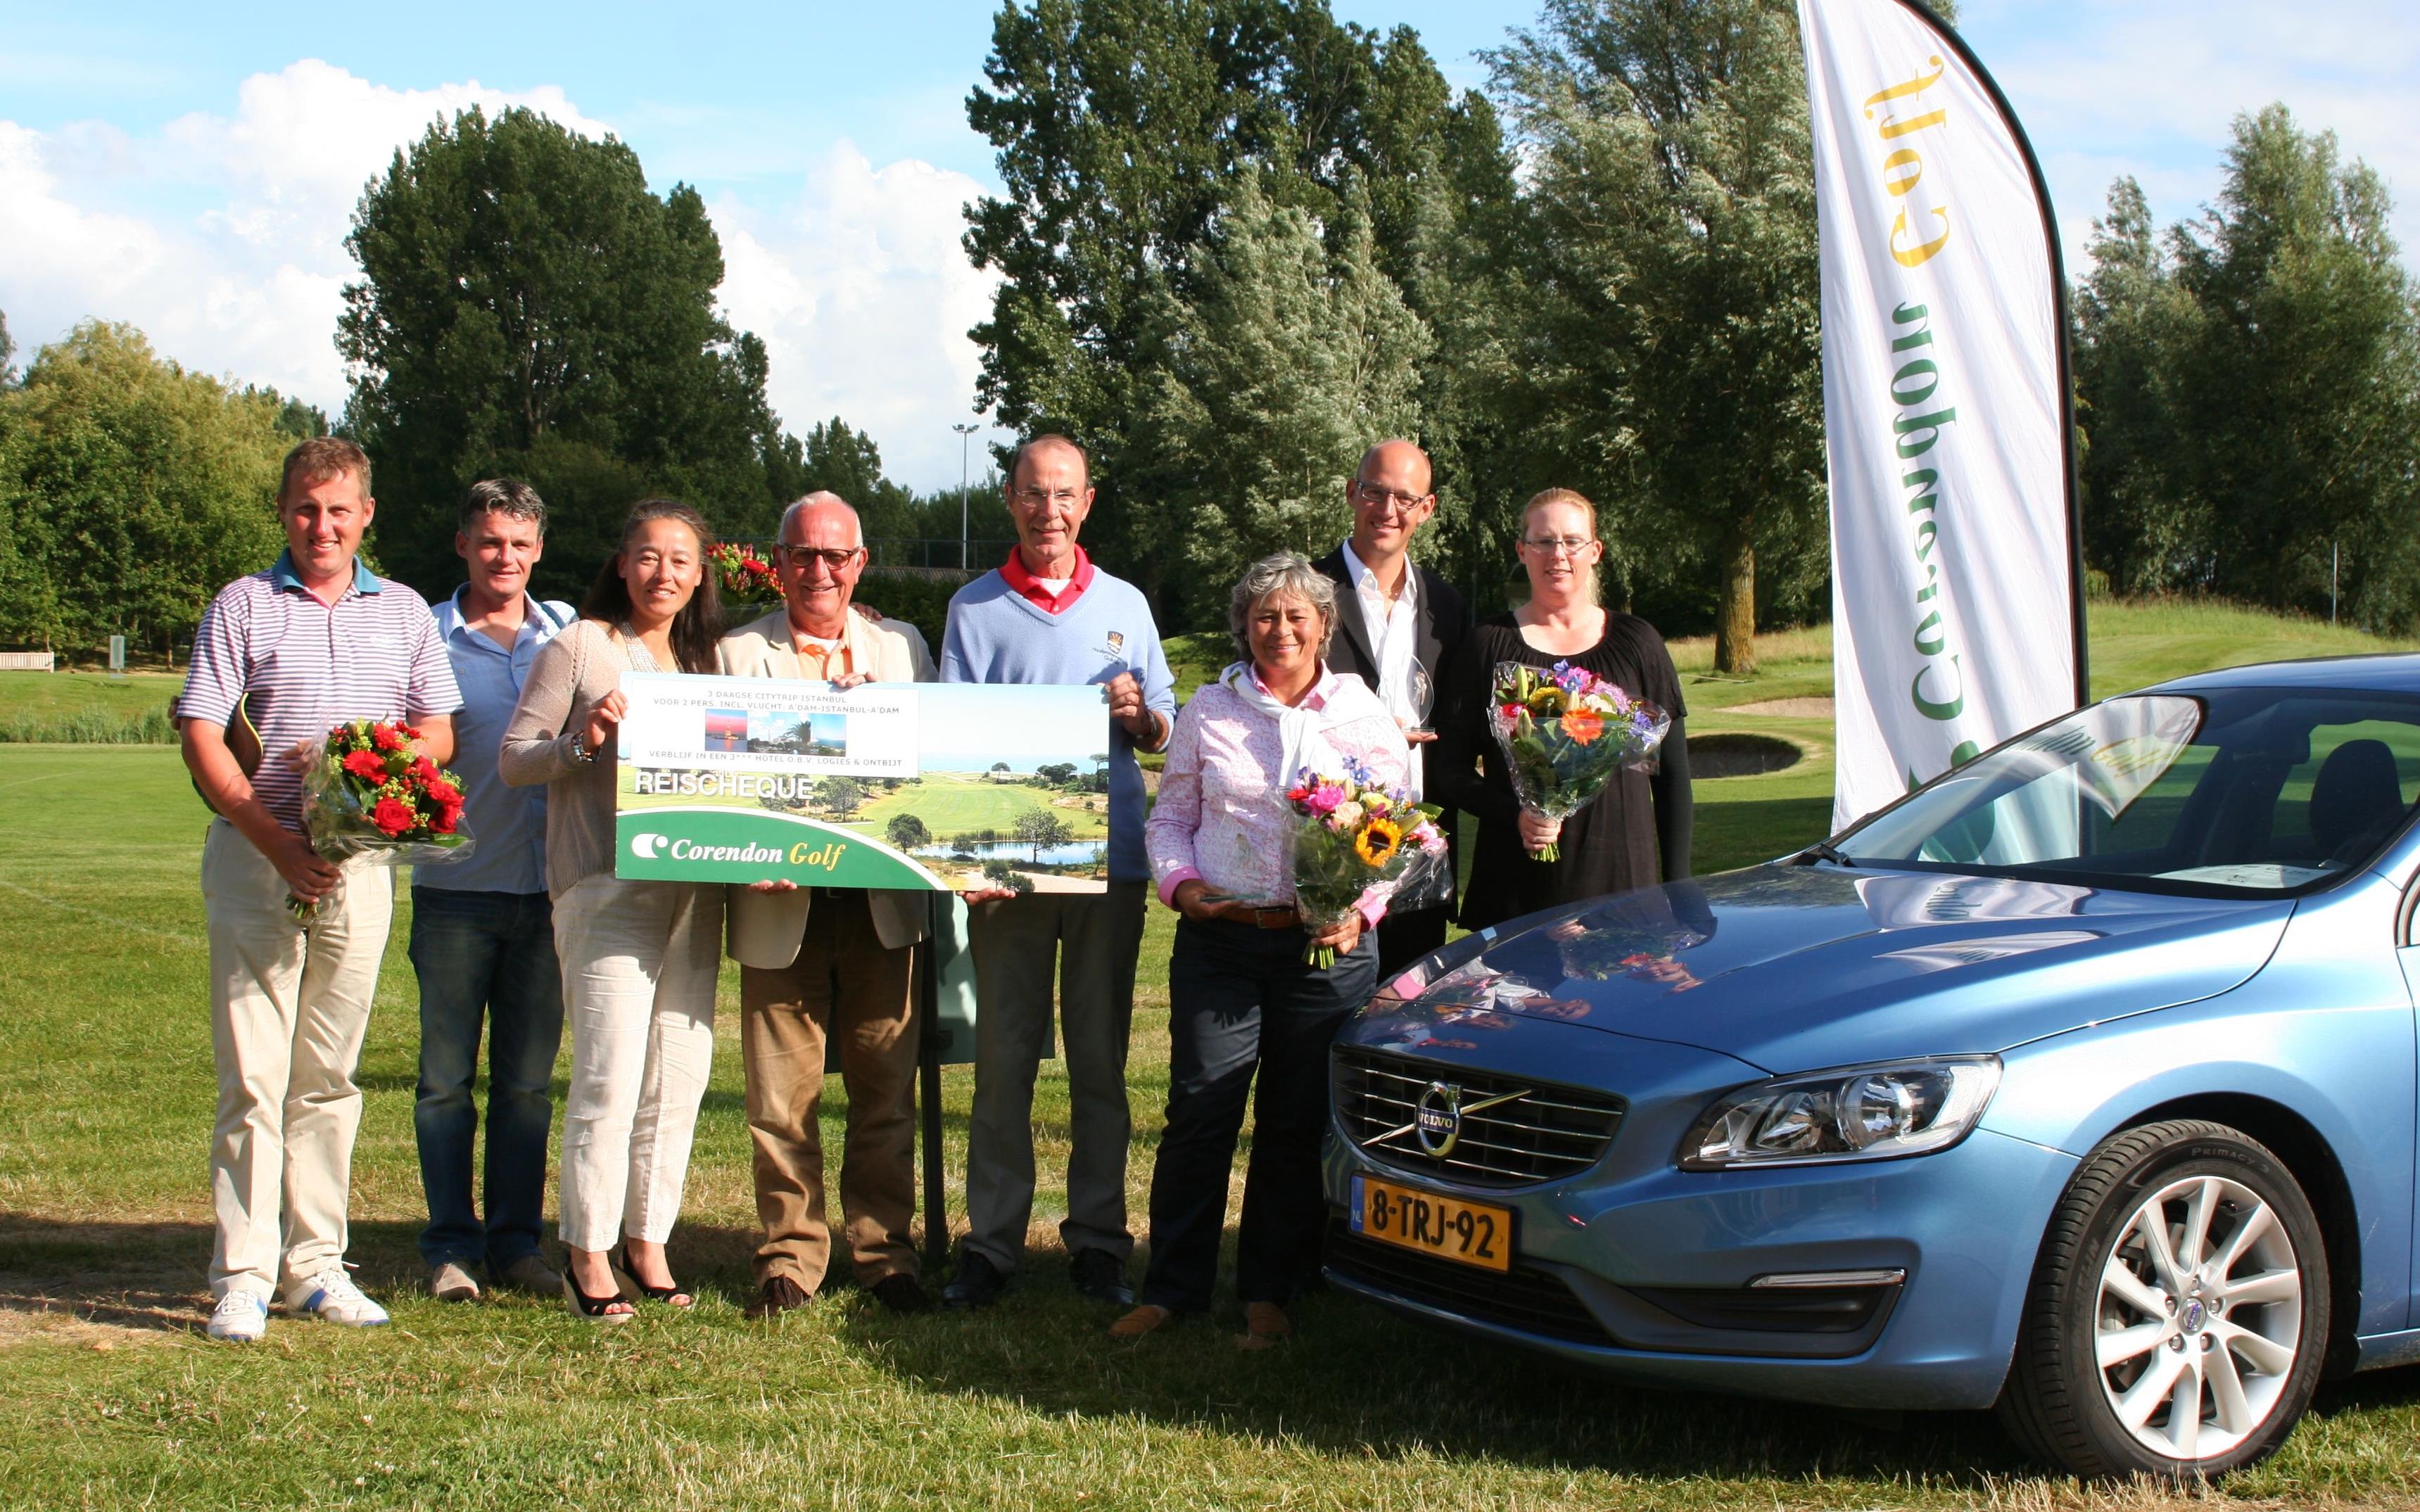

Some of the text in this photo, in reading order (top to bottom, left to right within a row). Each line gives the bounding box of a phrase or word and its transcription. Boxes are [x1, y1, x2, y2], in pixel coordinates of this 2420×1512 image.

[801, 694, 847, 703] ISTANBUL
[635, 771, 814, 801] REISCHEQUE
[671, 838, 847, 872] Corendon Golf
[1419, 1113, 1453, 1128] VOLVO
[2191, 1148, 2270, 1173] PRIMACY 3
[1352, 1209, 1362, 1223] NL
[1372, 1189, 1494, 1259] 8-TRJ-92
